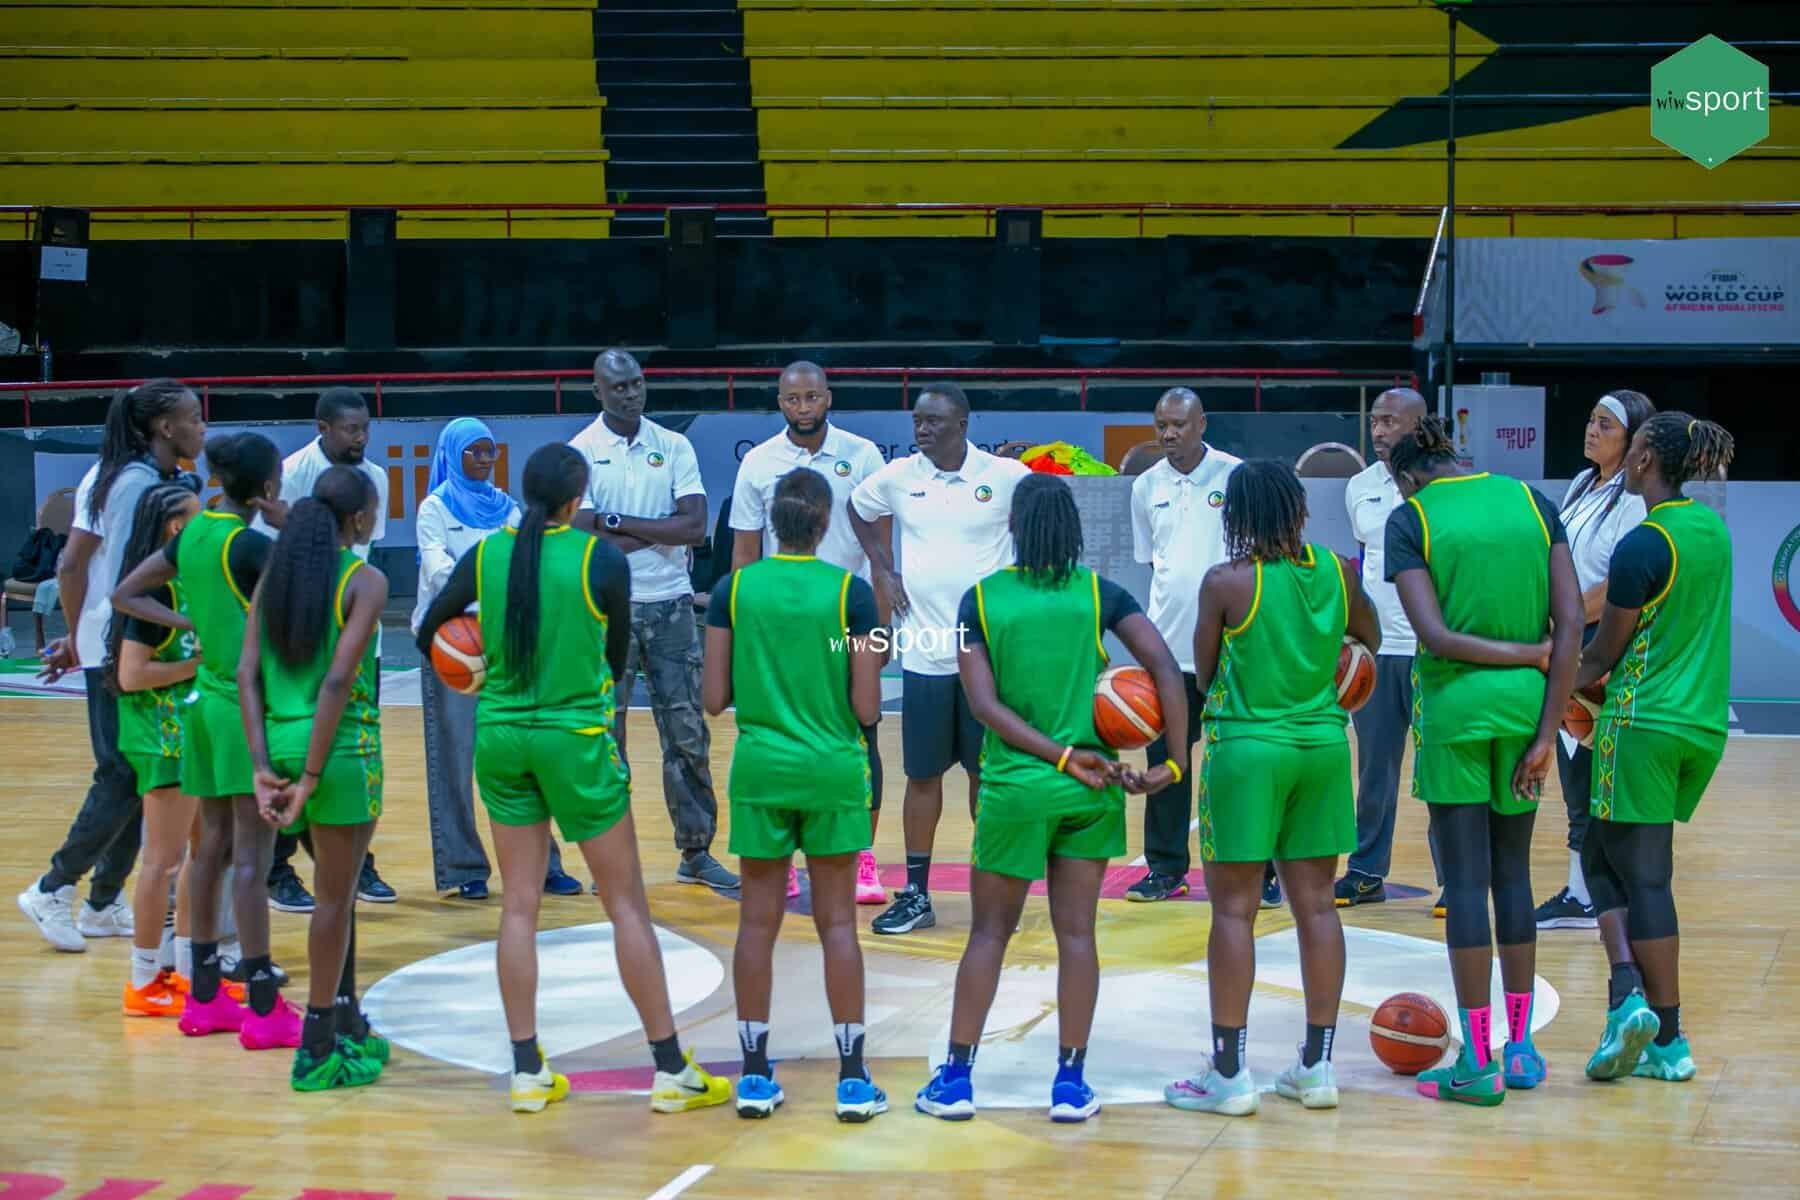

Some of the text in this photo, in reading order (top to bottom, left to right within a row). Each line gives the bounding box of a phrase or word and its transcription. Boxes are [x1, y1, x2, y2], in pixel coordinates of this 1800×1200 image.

[1665, 291, 1785, 301] WORLD CUP
[1496, 427, 1516, 439] STEP
[1517, 427, 1536, 449] UP
